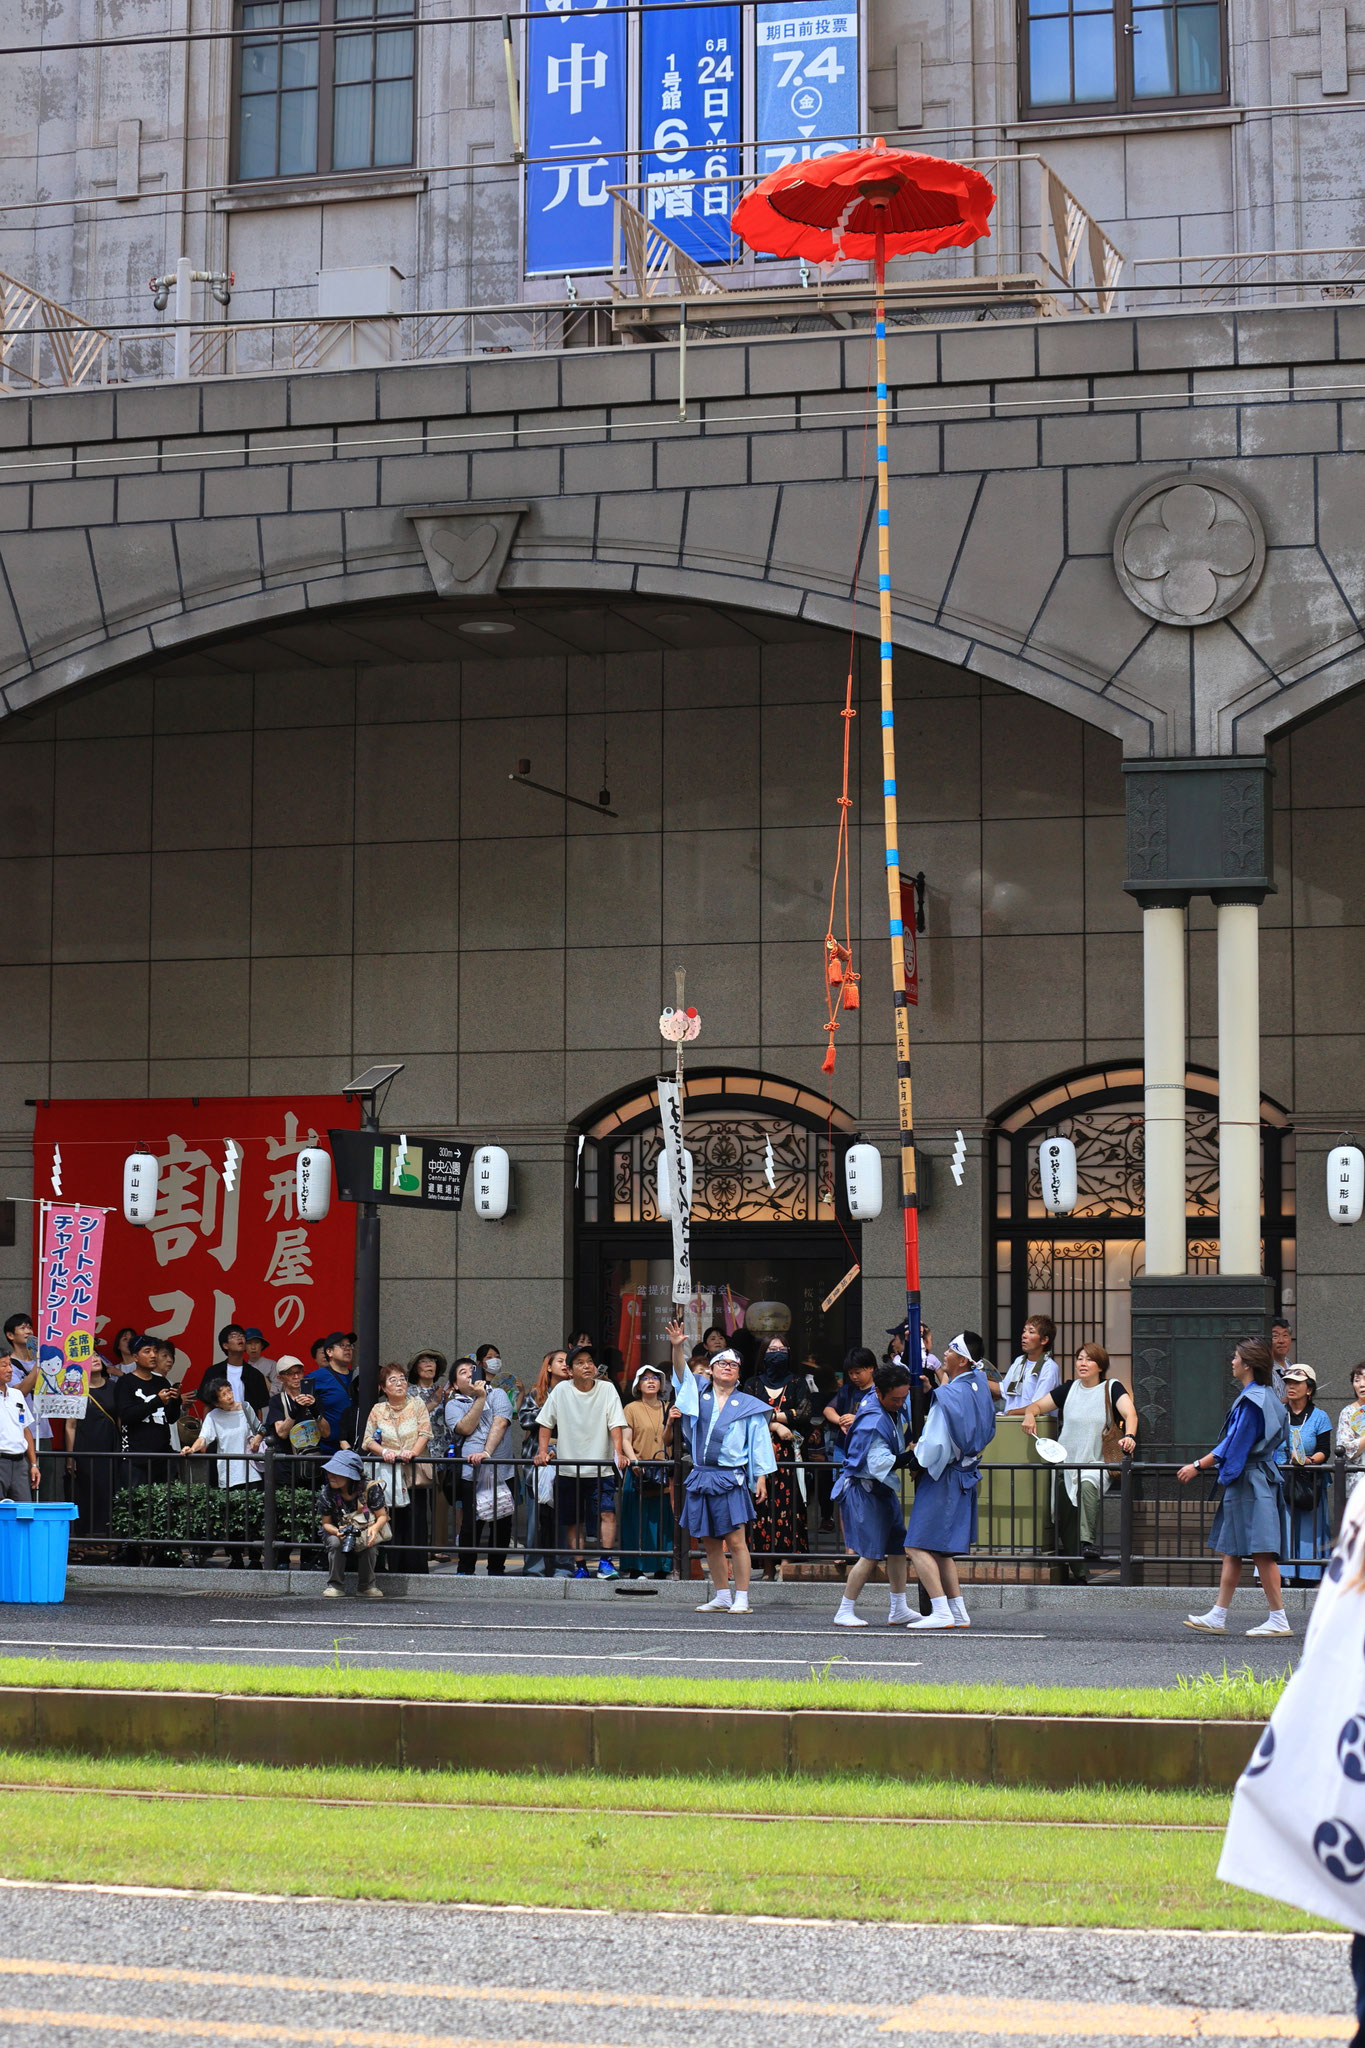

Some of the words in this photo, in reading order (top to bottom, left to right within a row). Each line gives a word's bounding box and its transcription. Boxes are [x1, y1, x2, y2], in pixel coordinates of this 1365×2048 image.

[766, 17, 849, 41] 期日前投票
[773, 46, 846, 88] 7.4
[439, 1147, 452, 1157] 300m
[429, 1159, 460, 1175] 中央公園
[428, 1174, 447, 1182] Central
[448, 1175, 461, 1183] Park
[428, 1183, 460, 1195] 避難場所
[46, 1215, 74, 1341] チャイルドシート
[71, 1216, 99, 1325] シートベルト
